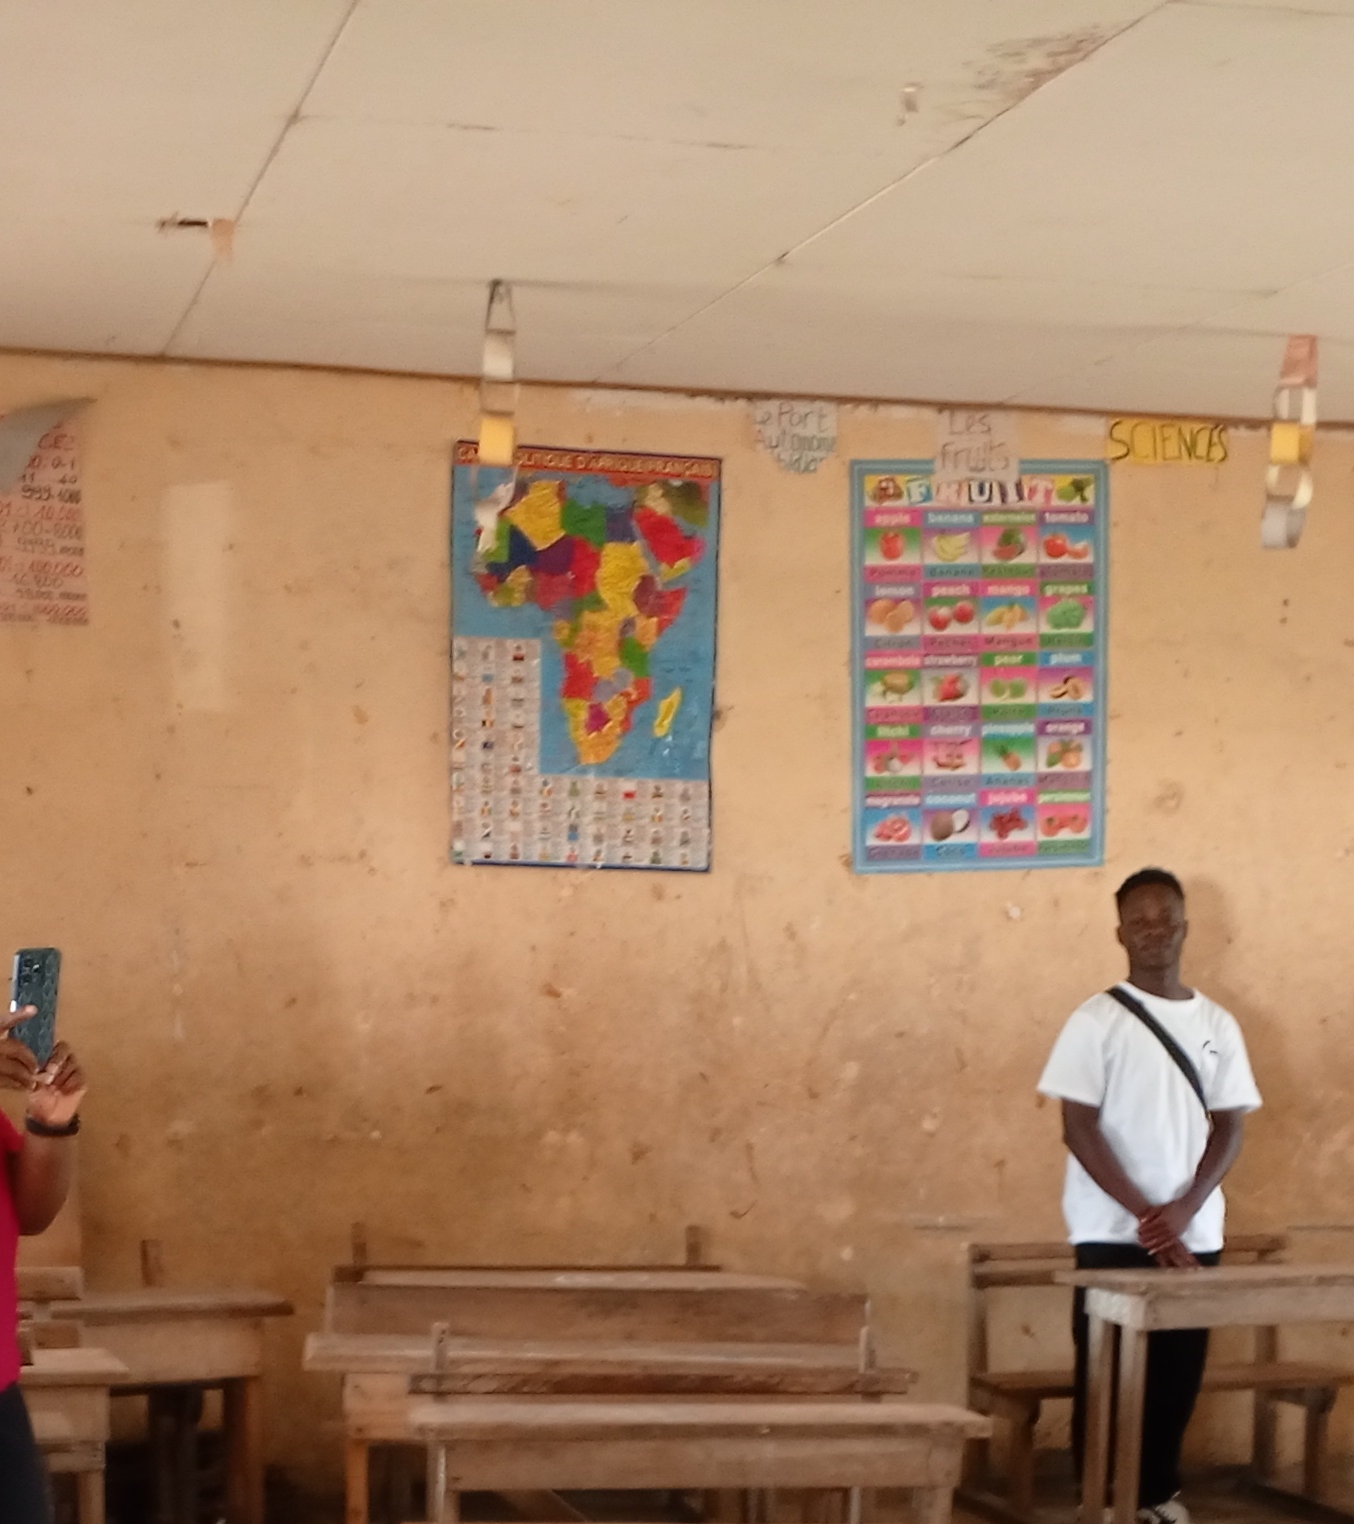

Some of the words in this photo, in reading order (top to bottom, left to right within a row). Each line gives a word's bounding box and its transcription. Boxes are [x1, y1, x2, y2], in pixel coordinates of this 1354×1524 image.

[948, 410, 992, 435] Les
[1109, 421, 1228, 464] SCIENCES
[874, 513, 911, 524] apple
[928, 512, 974, 524] banana
[1044, 512, 1089, 523] tomato
[931, 585, 971, 597] peach
[987, 584, 1030, 597] mango
[1044, 584, 1088, 597] grapes
[994, 654, 1023, 666] pear
